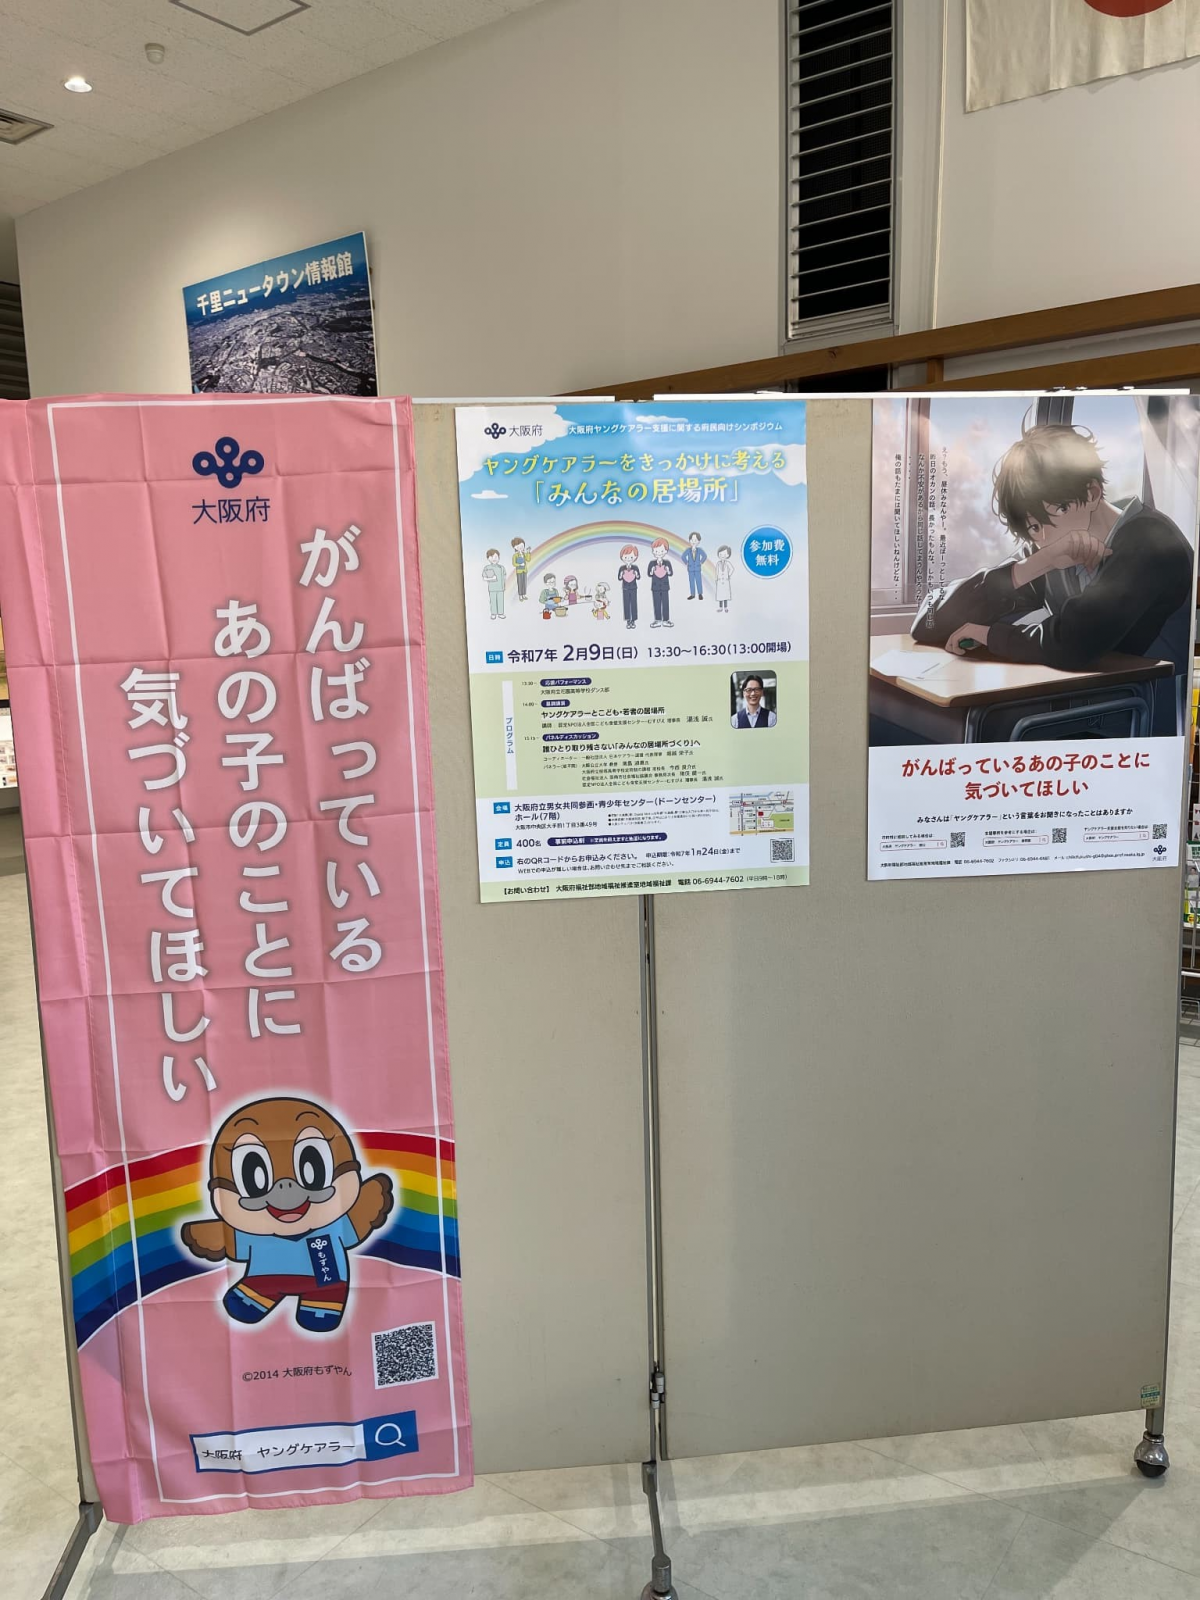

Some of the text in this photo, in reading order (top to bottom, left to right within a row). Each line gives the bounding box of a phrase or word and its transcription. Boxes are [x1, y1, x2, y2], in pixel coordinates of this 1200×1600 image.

[196, 251, 354, 316] 千里ニュータウン情報館
[508, 424, 543, 437] 大阪府
[568, 422, 783, 435] 大阪府ヤングケアラー支援に関する府民向けシンポジウム
[483, 449, 787, 477] ヤングケアラーをきっかけに考える
[534, 476, 741, 506] 「みんなの居場所」
[191, 496, 270, 524] 大阪府
[749, 539, 785, 552] 参加費
[755, 553, 780, 567] 無料
[507, 648, 558, 663] 令和7年
[505, 717, 514, 754] プログラム
[299, 525, 382, 972] がんばっている
[901, 752, 1150, 777] がんばっているあの子のことに
[965, 779, 1089, 800] 気づいてほしい
[214, 600, 301, 1038] あの子のことに
[514, 811, 560, 822] ホール(7階)
[516, 838, 541, 848] 400名
[516, 853, 638, 865] 右のQRコードからお申込みください。
[120, 668, 217, 1102] 気づいてほしい
[692, 875, 744, 885] 06-6944-7602
[317, 1251, 332, 1282] もずやん
[242, 1365, 353, 1382] ©2014 大阪府もずやん
[201, 1441, 356, 1461] 大阪府 ヤングケアラー
